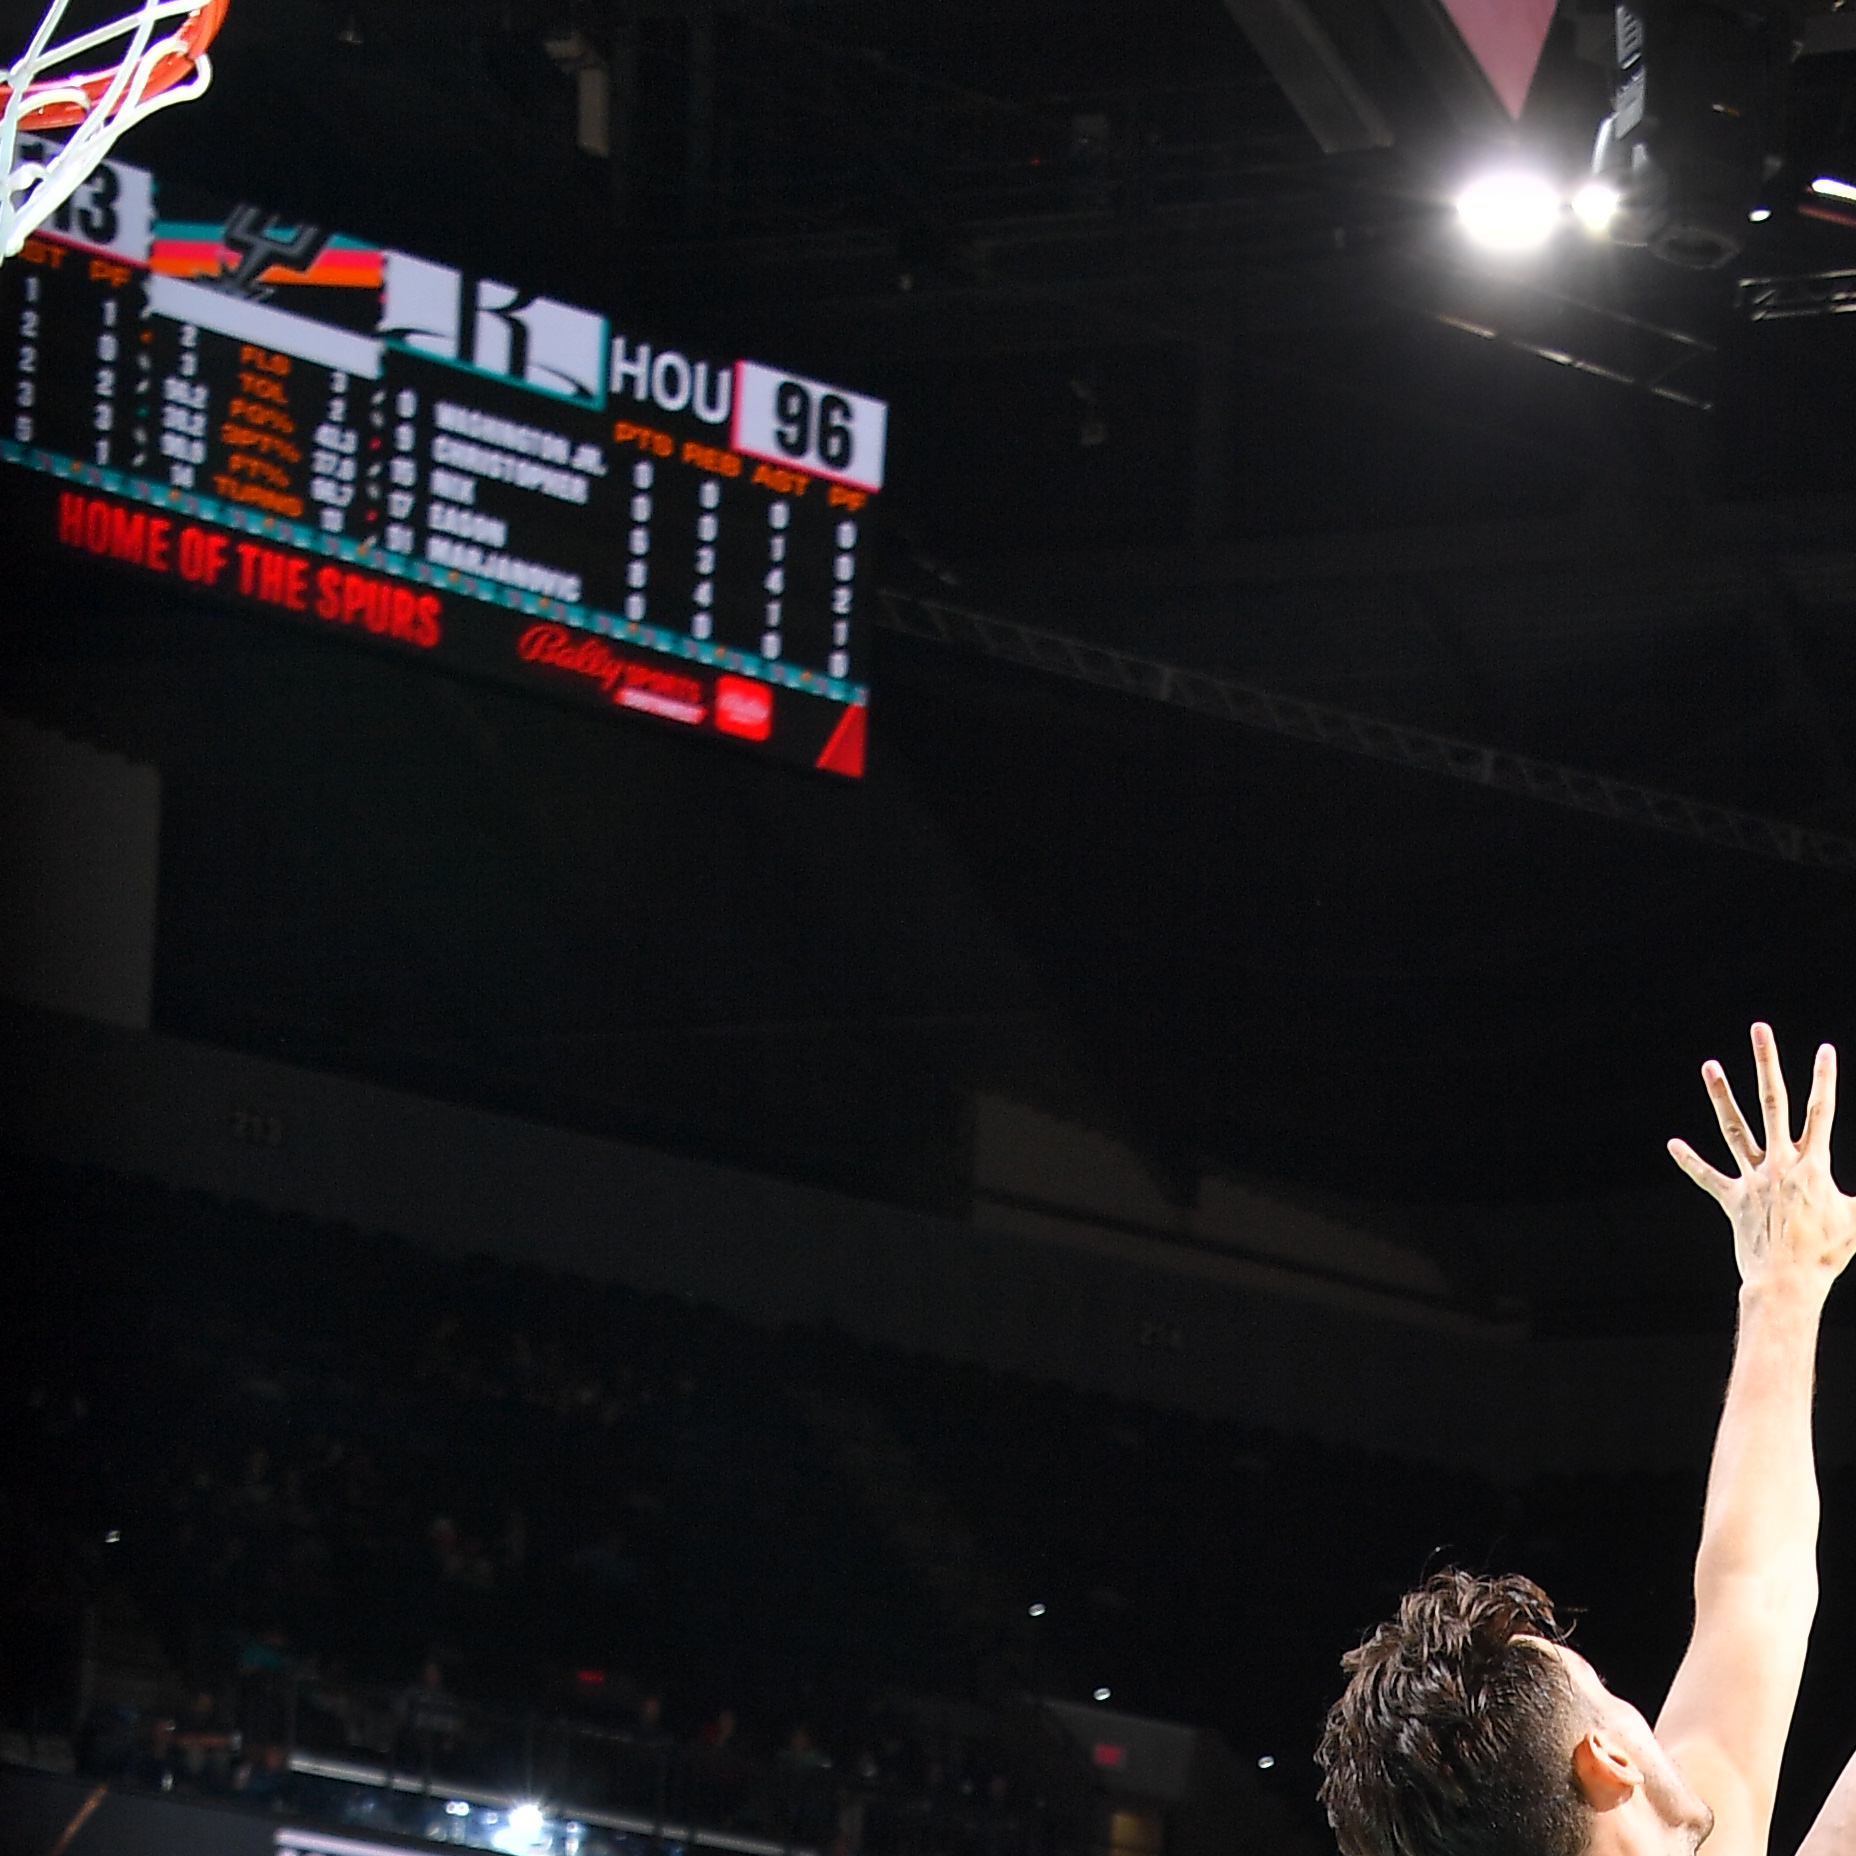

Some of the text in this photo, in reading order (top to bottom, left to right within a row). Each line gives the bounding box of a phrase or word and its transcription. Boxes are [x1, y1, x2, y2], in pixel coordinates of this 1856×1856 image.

[610, 335, 854, 472] HOU 96
[58, 491, 443, 649] HOME OF THE SPURS
